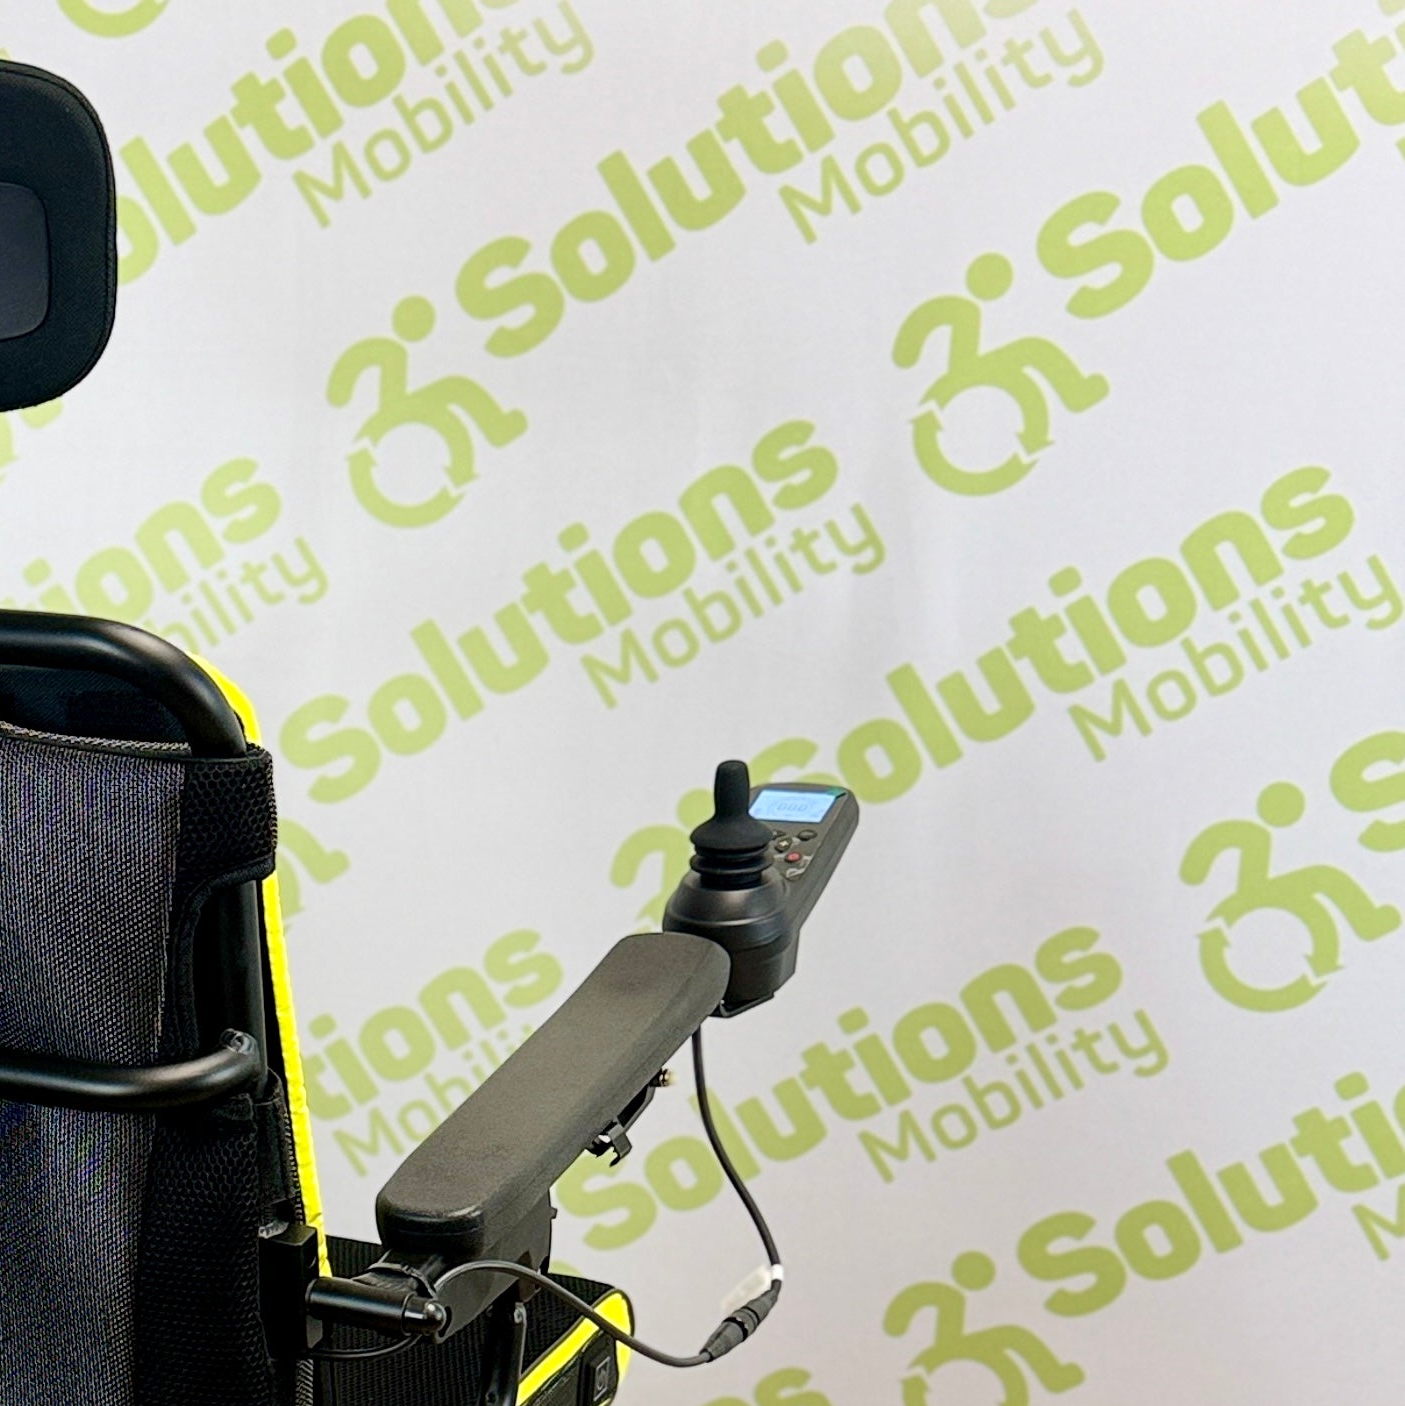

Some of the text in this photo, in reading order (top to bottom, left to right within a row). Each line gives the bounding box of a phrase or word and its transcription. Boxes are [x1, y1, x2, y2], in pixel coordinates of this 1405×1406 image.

[291, 1, 594, 229] Mobility
[778, 8, 1104, 244] Mobility
[279, 420, 840, 804] Solutions
[582, 504, 887, 709] Mobility
[1069, 554, 1403, 762] Mobility
[555, 926, 1124, 1252] Solutions
[859, 1009, 1171, 1183] Mobility
